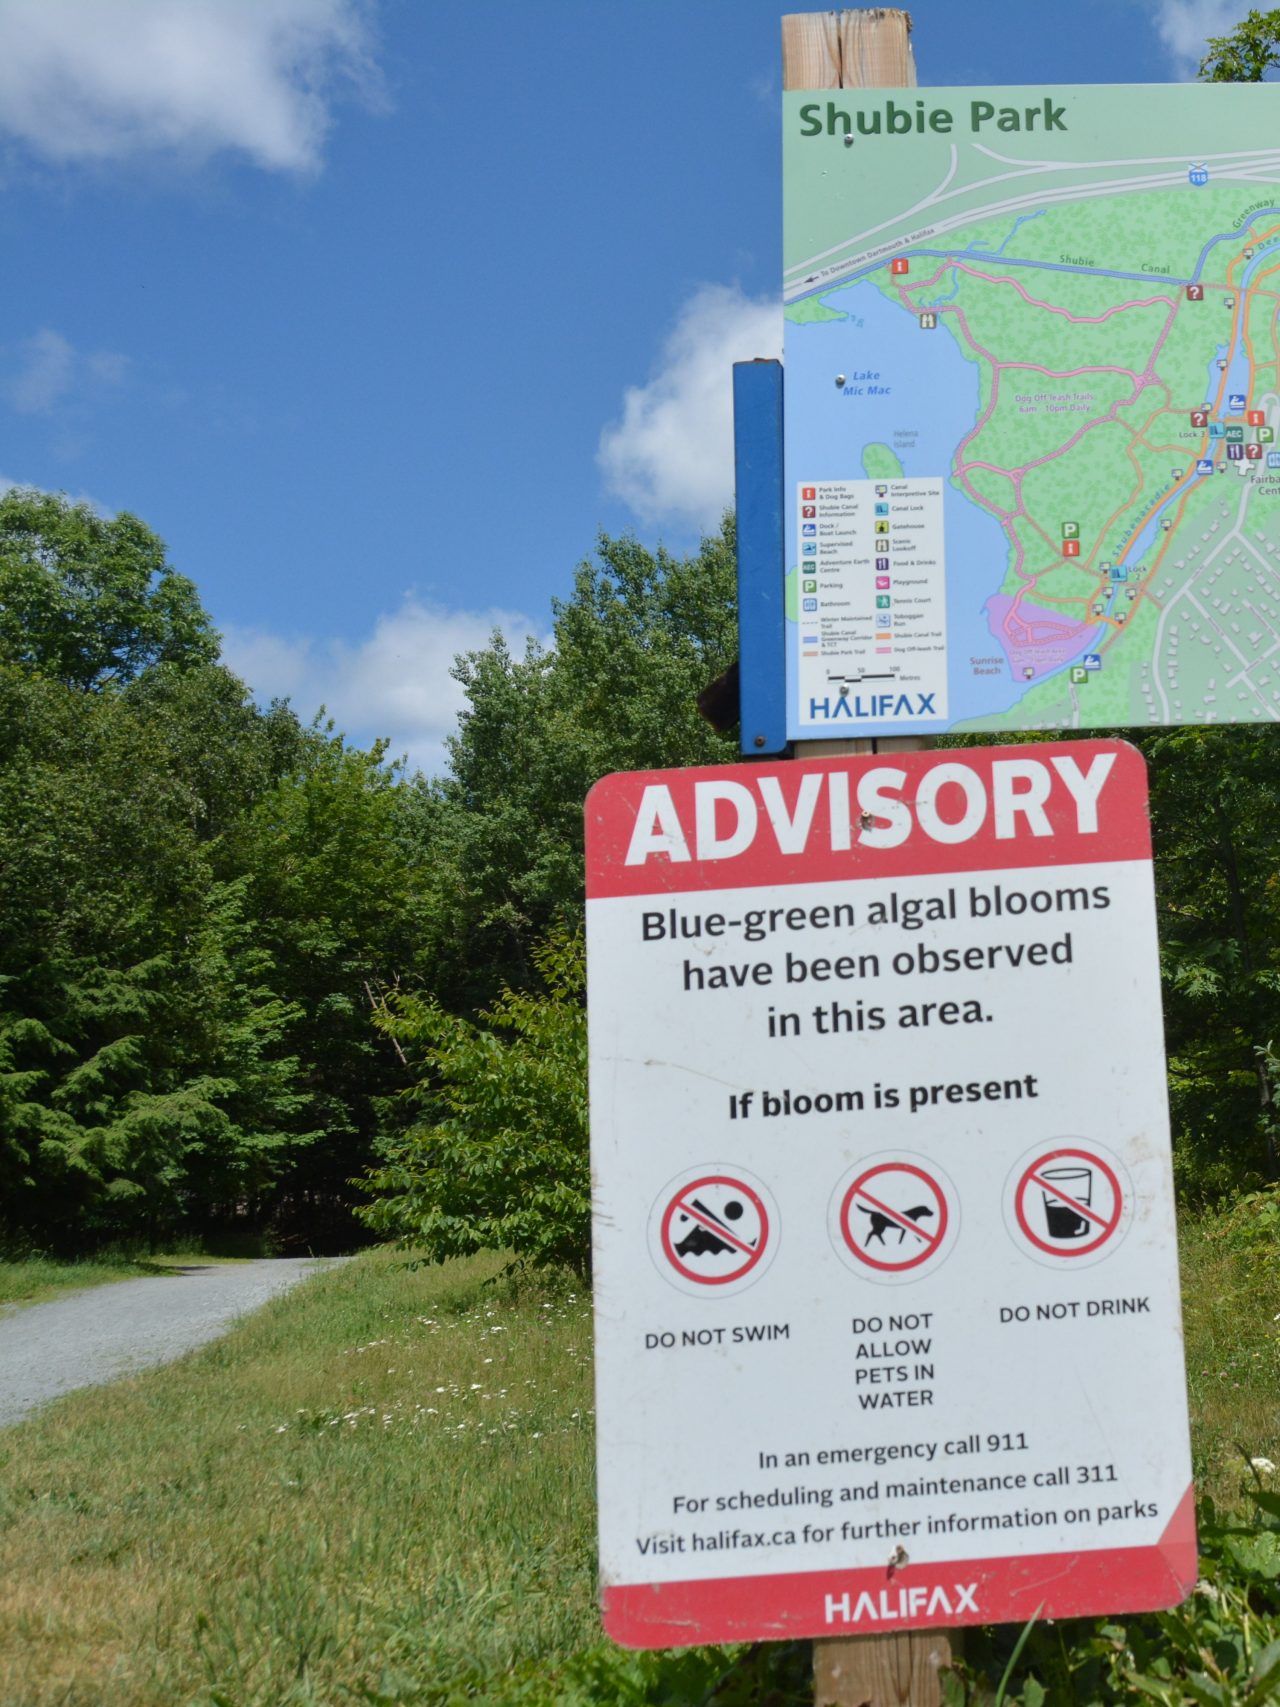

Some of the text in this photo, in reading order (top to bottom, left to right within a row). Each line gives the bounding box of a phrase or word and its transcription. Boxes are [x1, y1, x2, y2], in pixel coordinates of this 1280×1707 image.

[799, 99, 1068, 136] Shubie Park
[1192, 174, 1207, 182] 118
[1060, 254, 1095, 267] Shubie
[1142, 264, 1170, 274] Canal
[1232, 199, 1276, 228] Greenway
[821, 269, 829, 277] To
[831, 256, 866, 273] Downtown
[867, 240, 902, 258] Dartmouth
[911, 228, 934, 241] Halifax
[853, 371, 880, 381] Lake
[844, 386, 891, 395] Mic Mac
[1016, 395, 1032, 403] Dog
[1073, 392, 1093, 400] Trails
[1046, 405, 1068, 413] 10pm
[1071, 404, 1090, 412] Daily
[1227, 430, 1241, 438] AEC
[1113, 483, 1170, 557] Shubenacadie
[970, 657, 1003, 665] Sunrise
[973, 667, 1001, 675] Beach
[810, 693, 935, 719] HALIFAX
[624, 753, 1118, 867] ADVISORY
[641, 884, 1111, 942] Blue-green algal blooms
[683, 933, 1073, 991] have been observed
[768, 999, 994, 1038] in this area.
[729, 1075, 1038, 1120] If bloom is present
[852, 1314, 934, 1333] DO NOT
[999, 1299, 1149, 1323] DO NOT DRINK
[645, 1325, 789, 1350] DO NOT SWIM
[855, 1339, 932, 1359] ALLOW
[855, 1364, 934, 1384] PETS IN
[858, 1391, 934, 1409] WATER
[759, 1433, 1029, 1469] In an emergency call 911
[673, 1465, 1117, 1514] For scheduling and maintenance call 311
[636, 1500, 1158, 1556] Visit halifax.ca for further information on parks
[823, 1583, 979, 1624] HALIFAX
